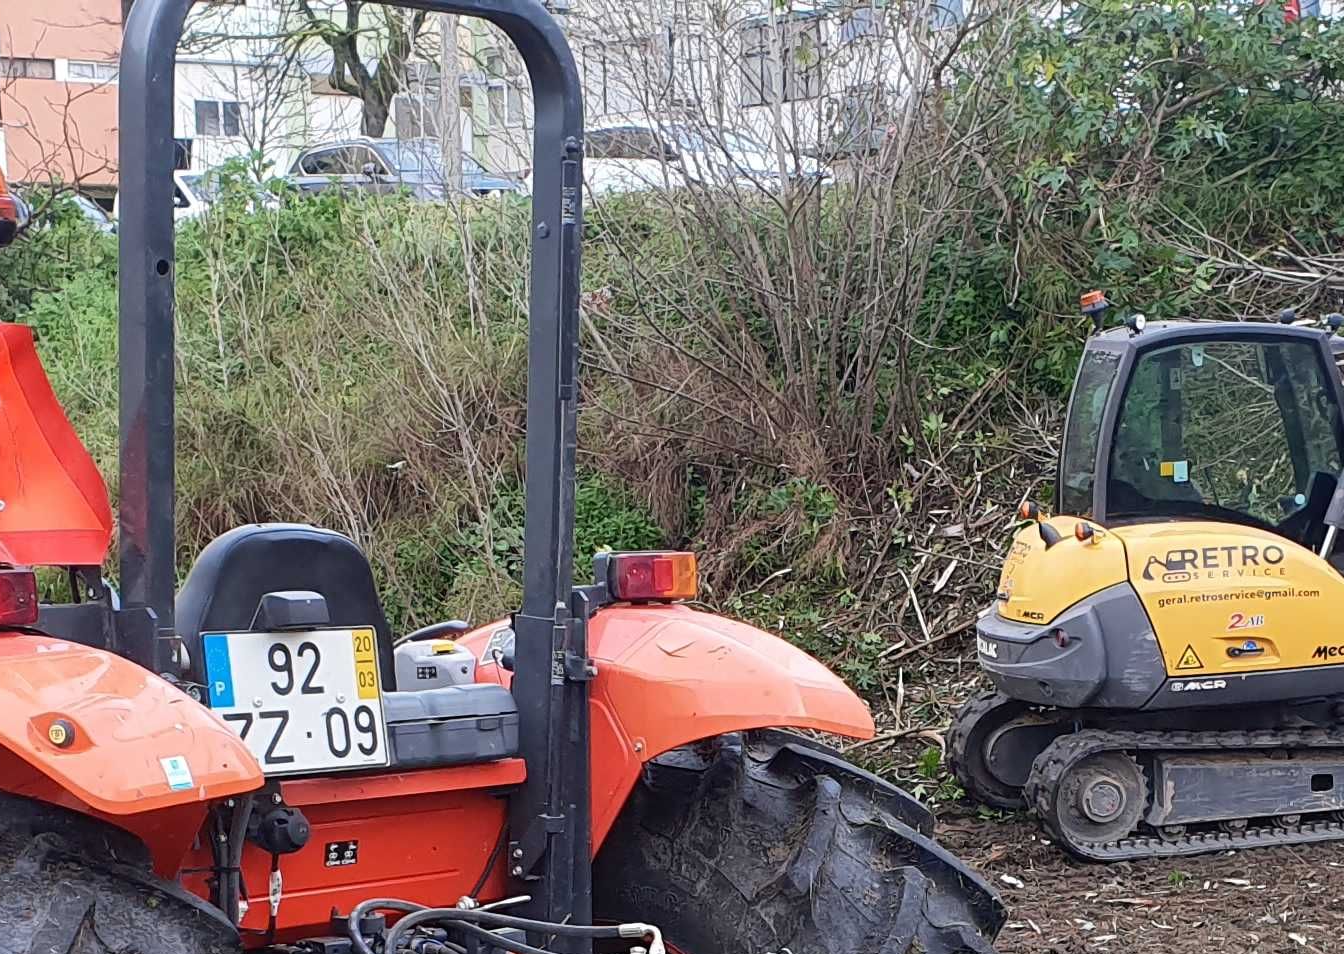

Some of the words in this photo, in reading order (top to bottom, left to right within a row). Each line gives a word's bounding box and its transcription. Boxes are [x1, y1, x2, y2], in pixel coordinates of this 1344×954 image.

[1181, 545, 1285, 569] RETRO
[1192, 567, 1287, 580] SERVICE
[1157, 588, 1321, 608] geral.retroservice@gmail.com
[354, 636, 371, 653] 20
[267, 641, 325, 697] 92
[358, 671, 375, 688] 03
[1183, 679, 1228, 692] MCR
[214, 680, 227, 697] P
